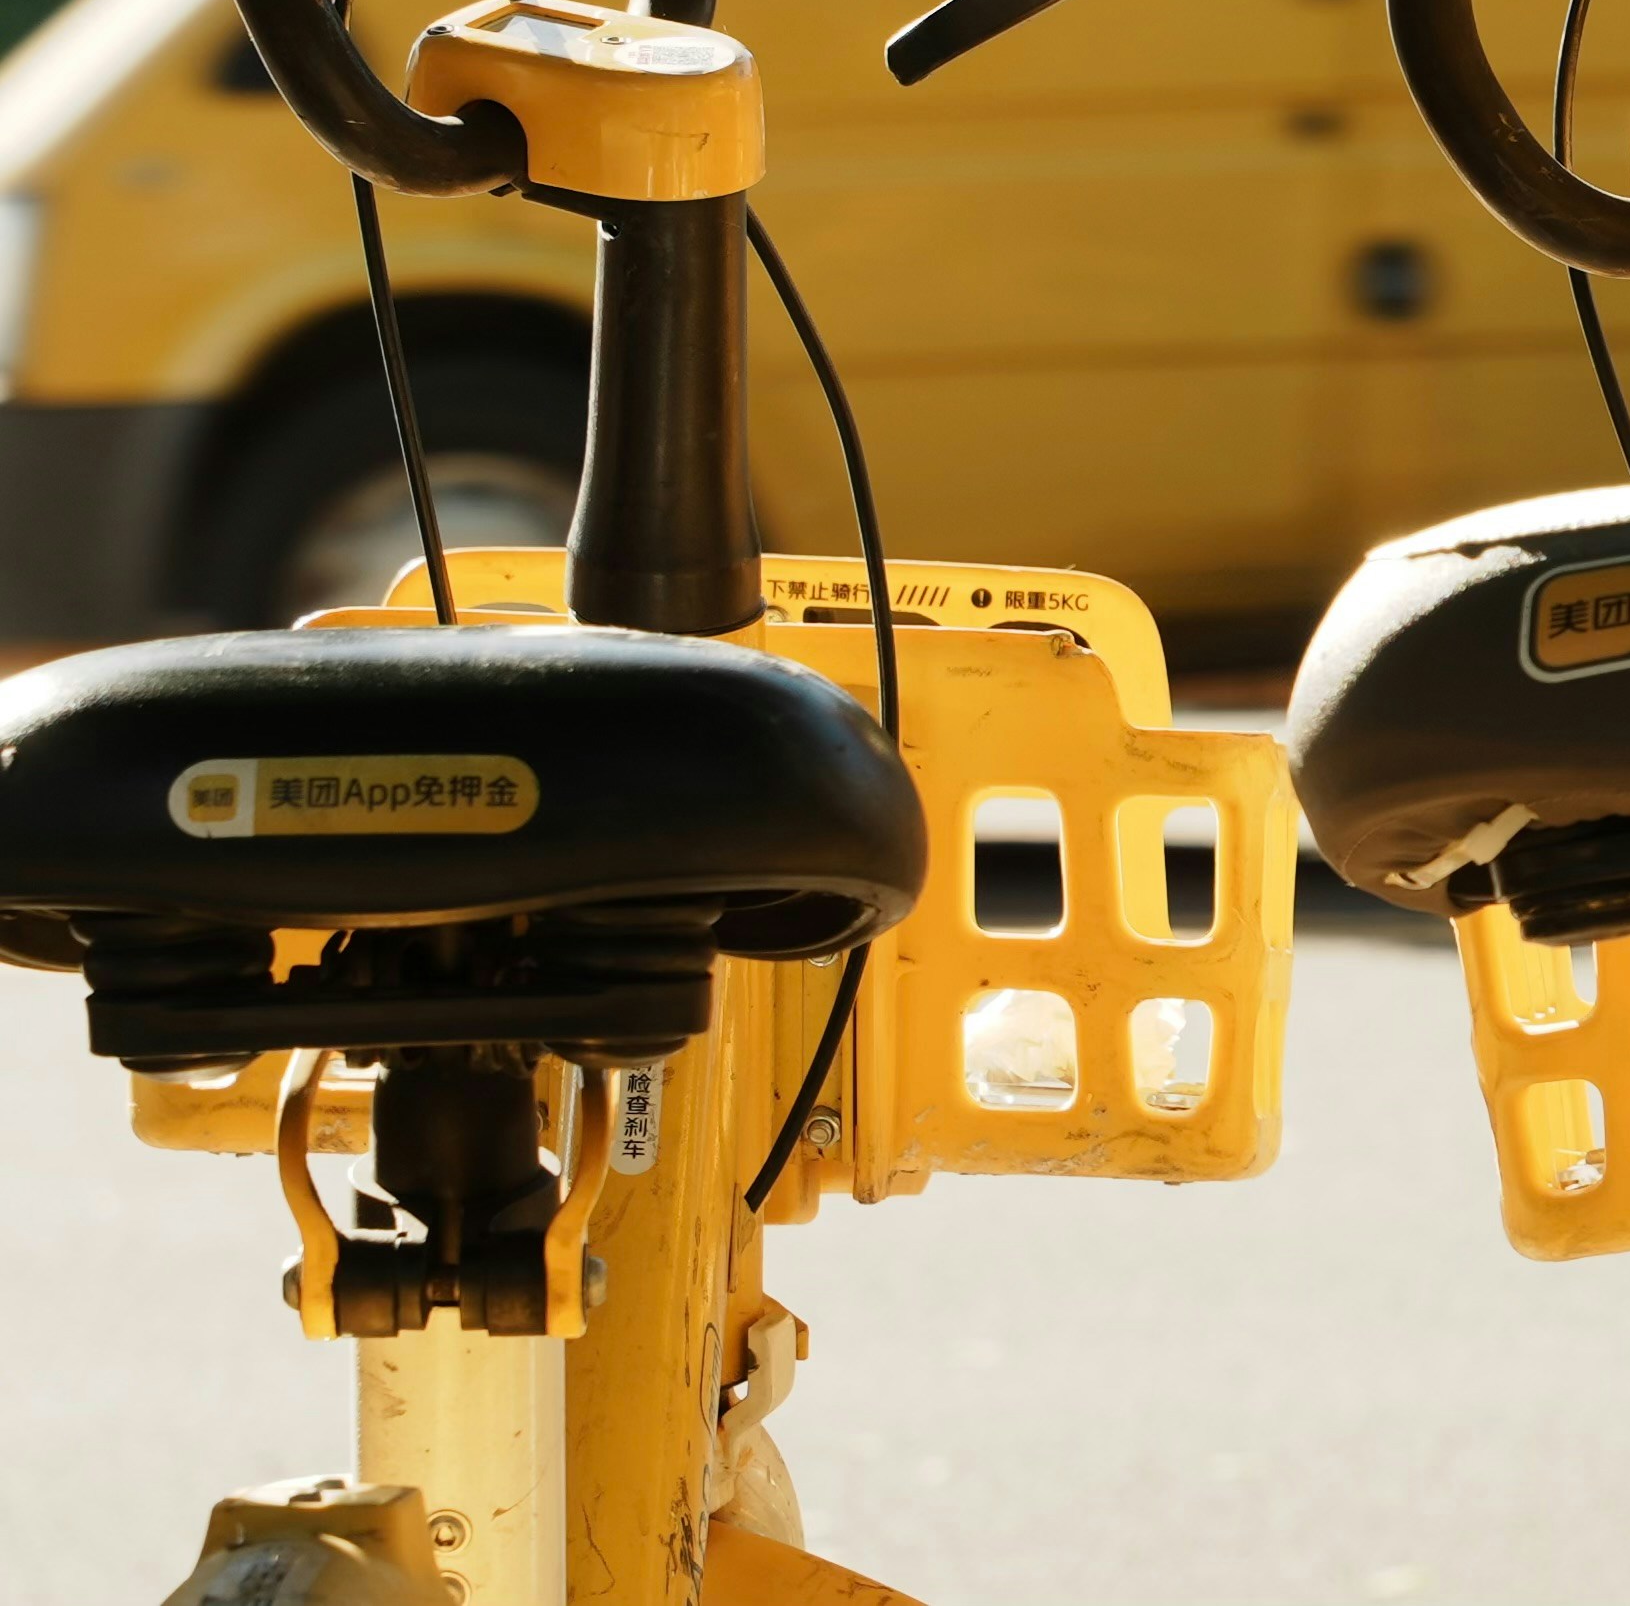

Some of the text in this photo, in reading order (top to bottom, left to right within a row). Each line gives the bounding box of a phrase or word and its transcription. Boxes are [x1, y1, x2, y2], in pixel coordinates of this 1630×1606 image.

[1004, 589, 1090, 612] 限重5KG
[270, 774, 519, 812] 美团App免押金
[621, 1065, 651, 1160] 检查刹车
